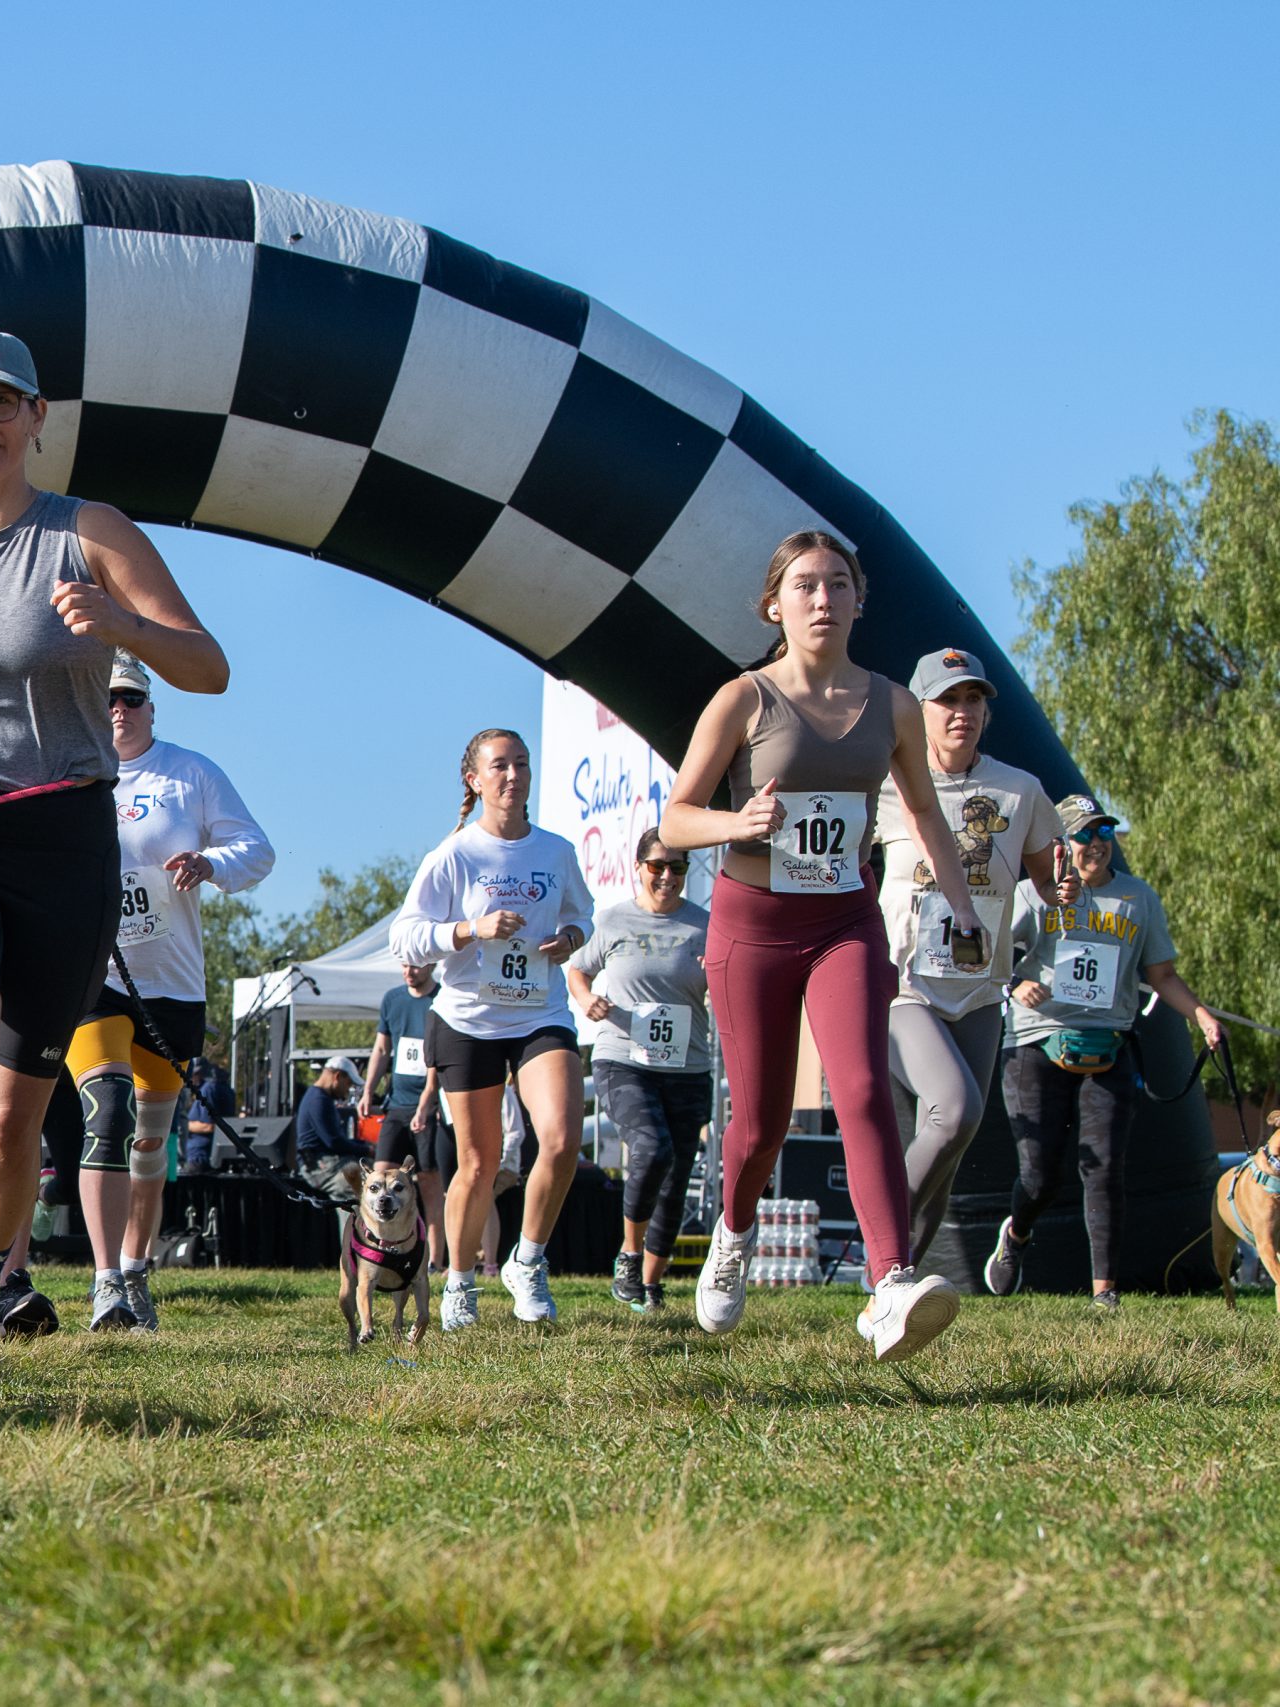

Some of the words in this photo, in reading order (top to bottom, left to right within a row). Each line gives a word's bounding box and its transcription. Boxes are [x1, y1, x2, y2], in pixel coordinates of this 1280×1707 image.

[132, 794, 167, 822] 5K
[794, 817, 846, 856] 102
[782, 860, 819, 870] Salute
[787, 870, 817, 881] Paws
[830, 857, 849, 886] 5K
[477, 874, 520, 887] Salute
[485, 886, 519, 898] Paws
[531, 871, 558, 902] 5K
[121, 886, 150, 917] 39
[1044, 907, 1081, 934] U.S.
[1088, 911, 1138, 945] NAVY
[501, 953, 528, 981] 63
[1073, 957, 1099, 982] 56
[649, 1018, 674, 1043] 55
[406, 1047, 419, 1062] 60
